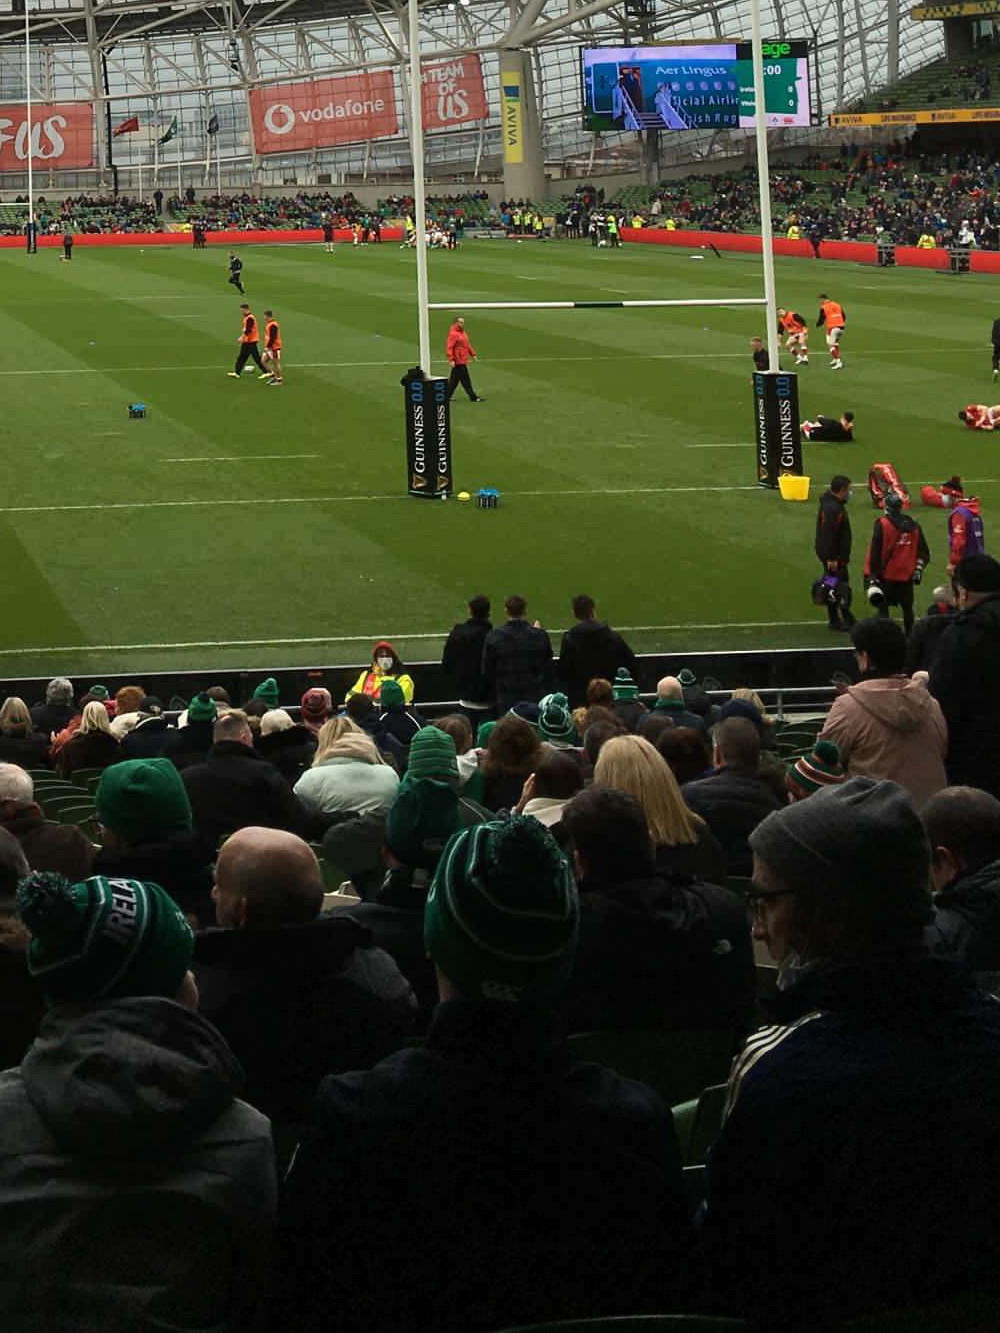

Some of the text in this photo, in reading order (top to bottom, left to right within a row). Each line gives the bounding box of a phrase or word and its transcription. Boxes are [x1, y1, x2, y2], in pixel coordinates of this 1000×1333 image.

[762, 43, 791, 58] age
[655, 66, 728, 77] Aer Lingus
[437, 89, 470, 121] US
[438, 82, 458, 96] OF
[300, 98, 385, 123] vodafone
[506, 106, 518, 146] AVIVA
[411, 382, 425, 473] GUINNESS 0.0
[437, 405, 447, 473] GUINNESS
[780, 400, 794, 466] GUINNESS
